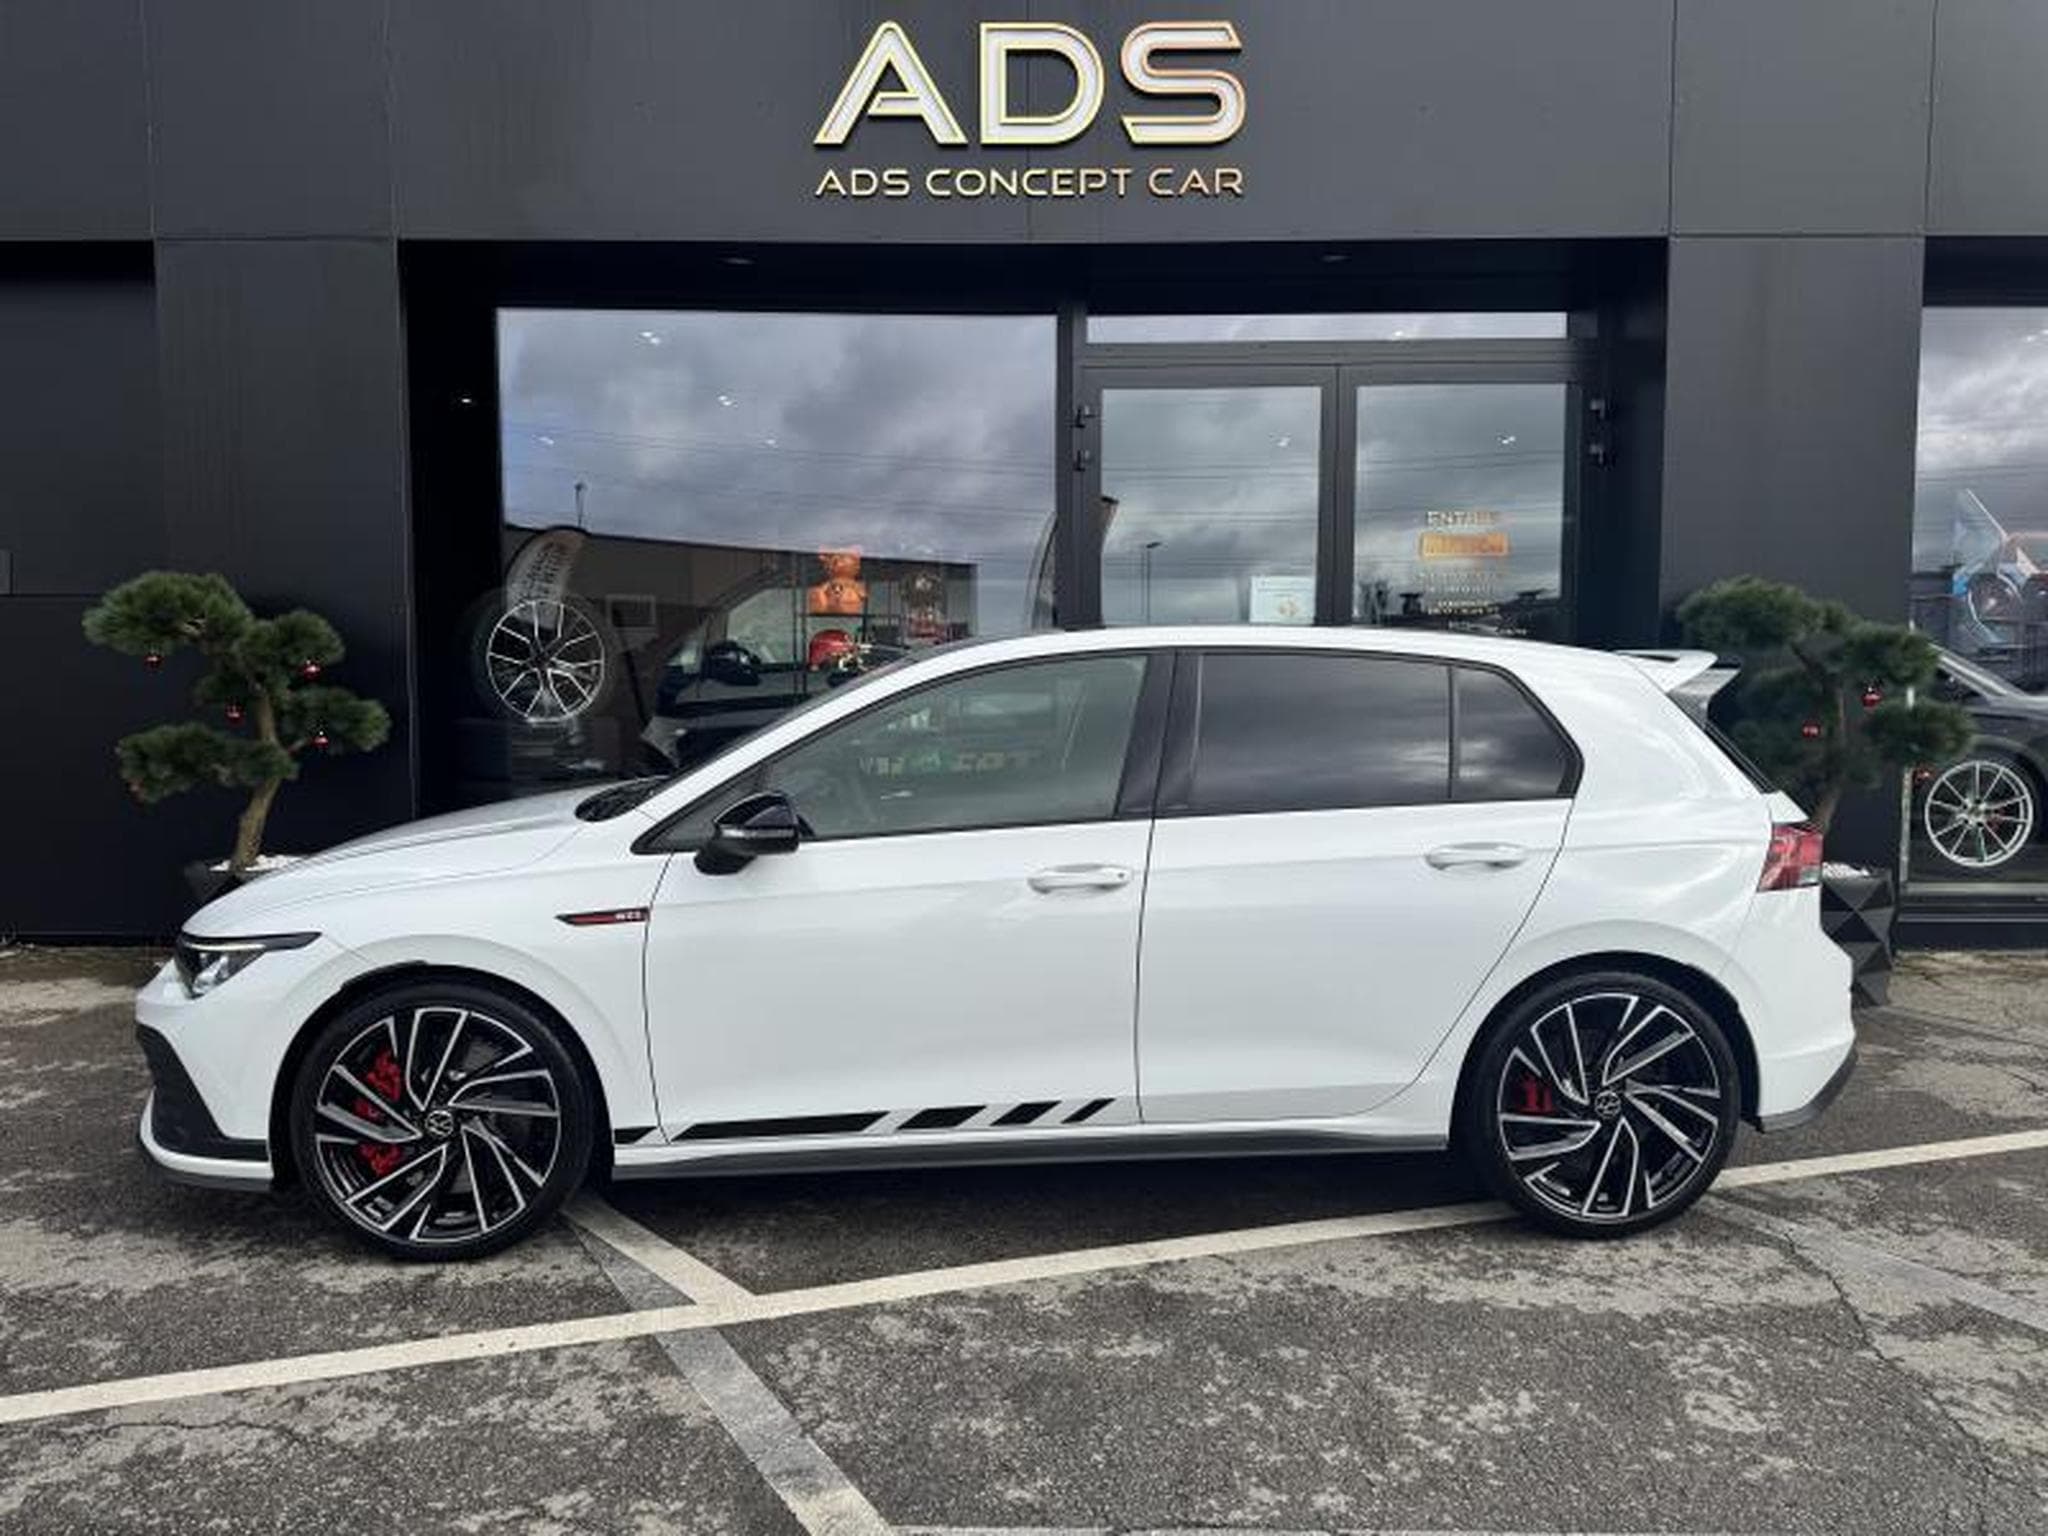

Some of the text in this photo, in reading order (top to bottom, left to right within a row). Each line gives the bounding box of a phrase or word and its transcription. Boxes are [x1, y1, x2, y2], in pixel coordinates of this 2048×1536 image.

[813, 20, 1246, 145] ADS
[815, 168, 1244, 197] ADS CONCEPT CAR
